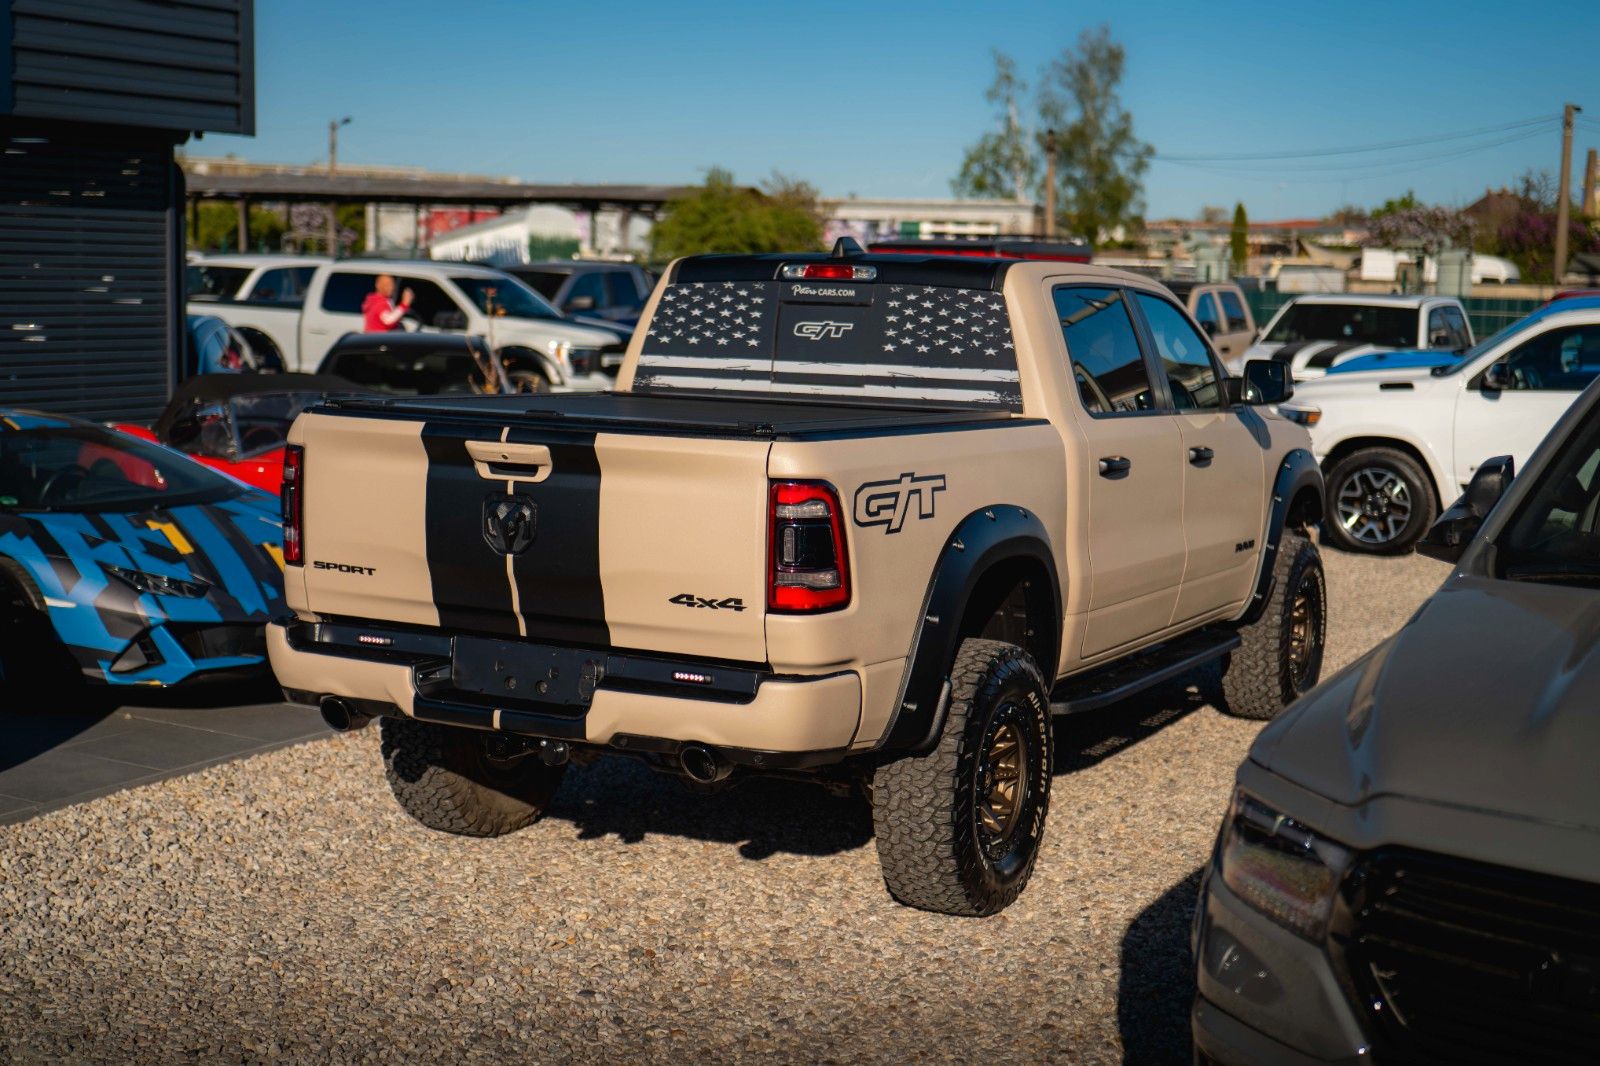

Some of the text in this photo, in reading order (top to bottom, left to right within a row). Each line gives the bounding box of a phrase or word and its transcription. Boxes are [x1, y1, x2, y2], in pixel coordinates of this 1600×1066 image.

[818, 288, 856, 297] CARS.COM
[313, 561, 377, 576] SPORT
[1027, 691, 1048, 793] All-Terrain
